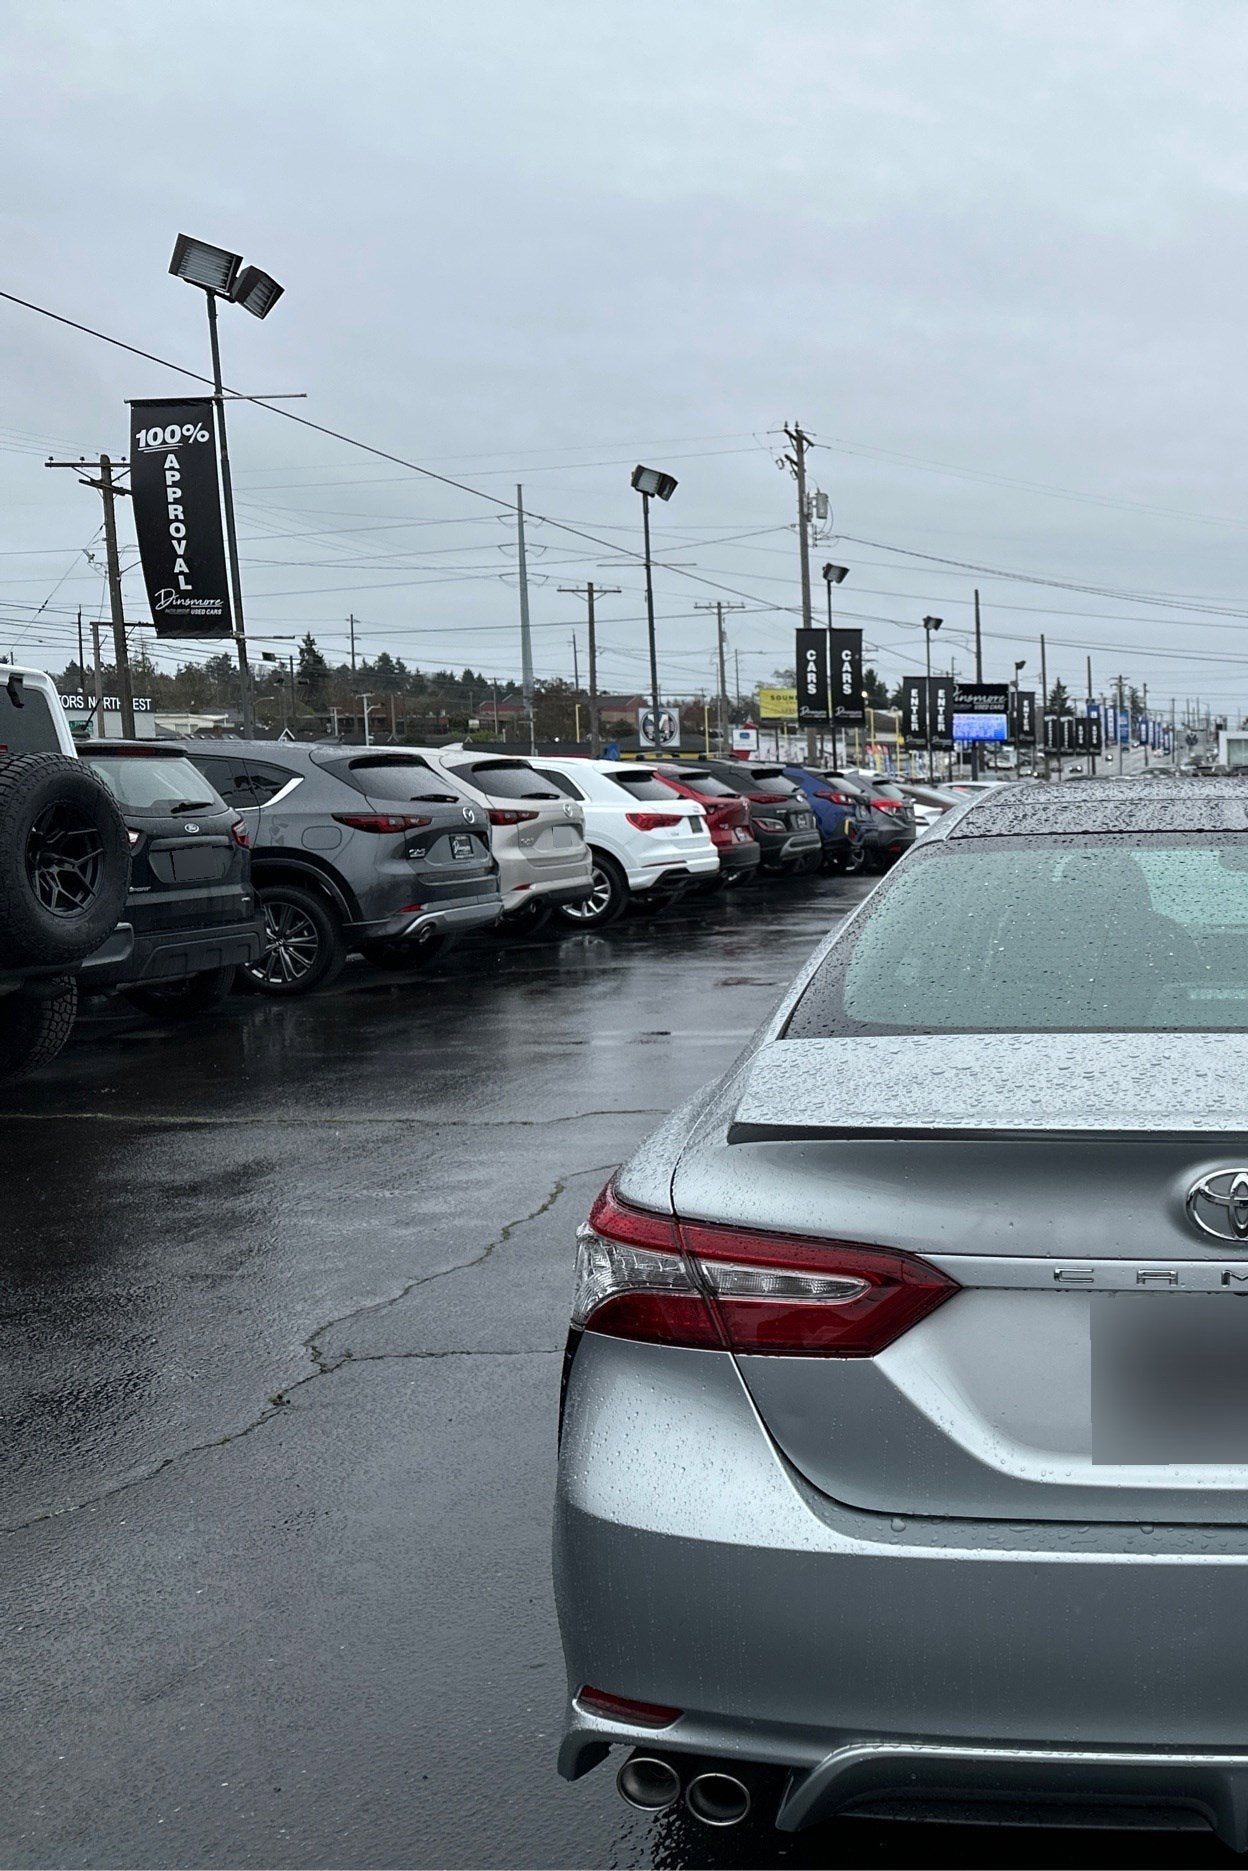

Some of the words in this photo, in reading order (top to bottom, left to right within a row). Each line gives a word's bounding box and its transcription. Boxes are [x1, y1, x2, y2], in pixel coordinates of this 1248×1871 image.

[135, 422, 209, 447] 100%
[164, 453, 193, 590] APPROVAL
[154, 588, 224, 611] Dinsmore
[806, 649, 817, 695] CARS
[841, 649, 852, 695] CARS
[910, 688, 919, 732] ENTER
[937, 688, 946, 732] ENTER
